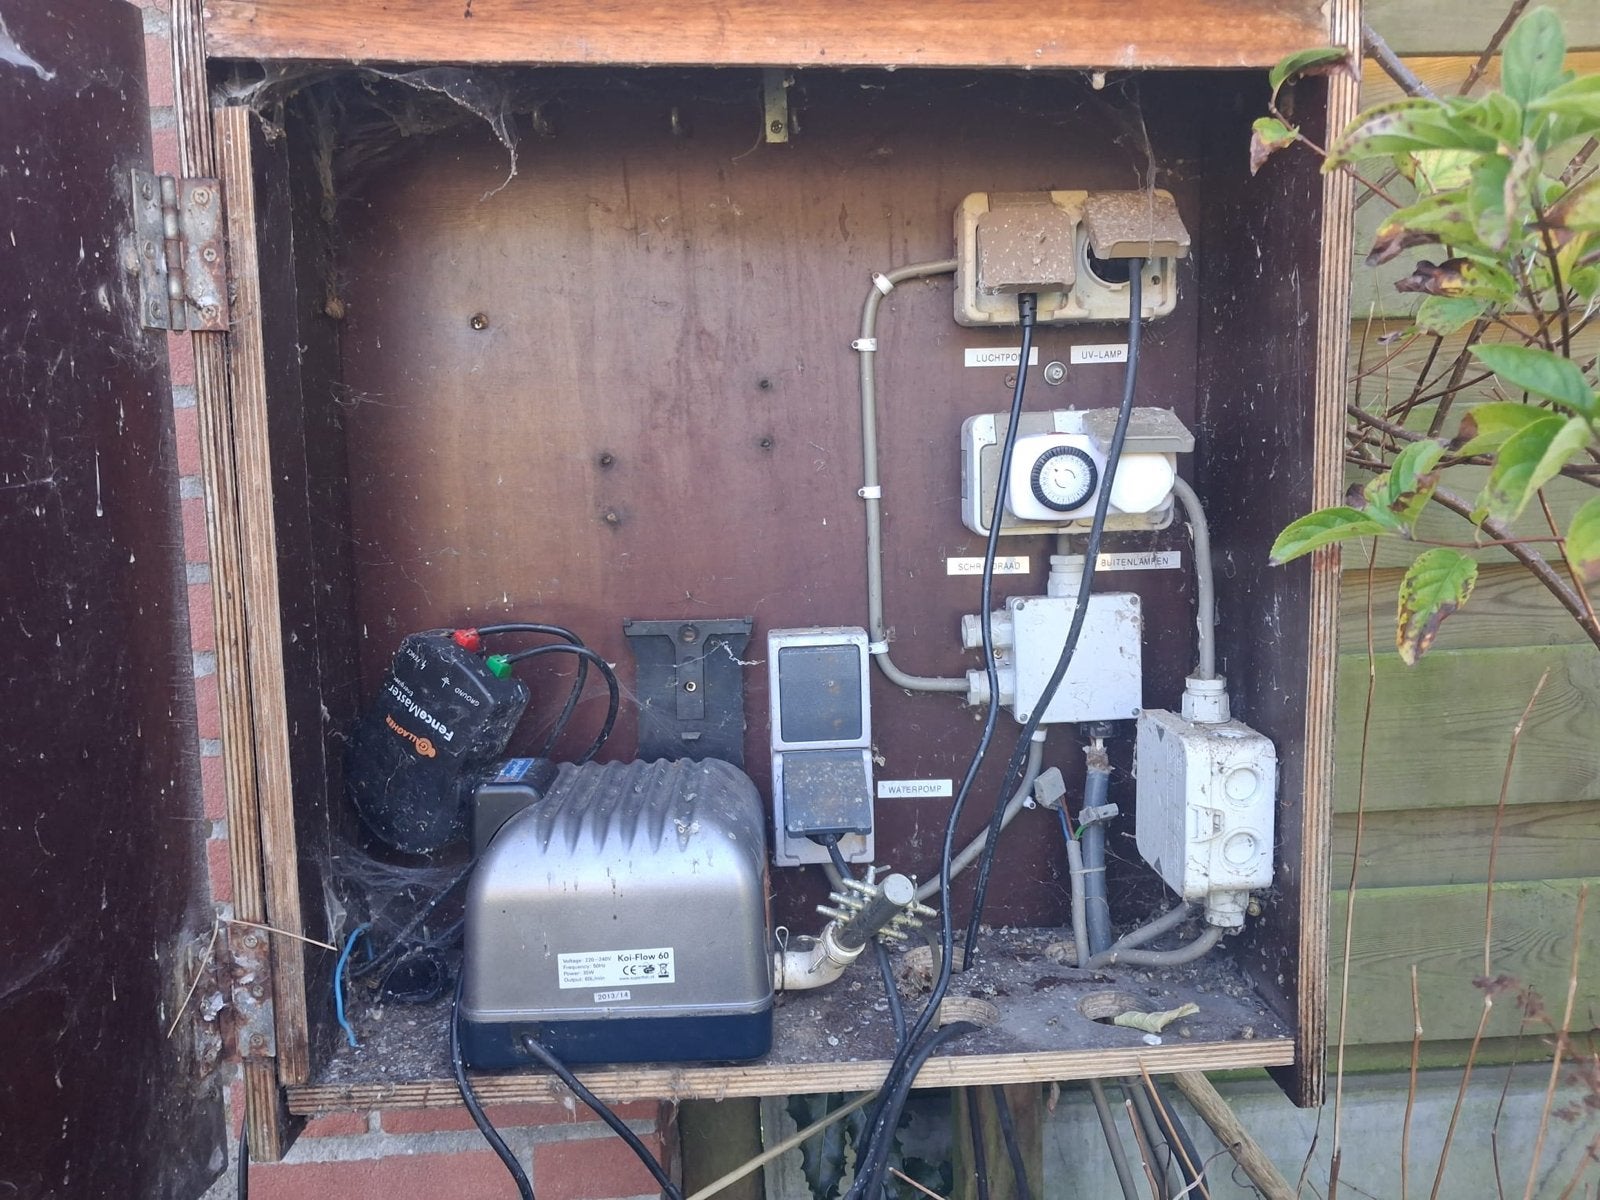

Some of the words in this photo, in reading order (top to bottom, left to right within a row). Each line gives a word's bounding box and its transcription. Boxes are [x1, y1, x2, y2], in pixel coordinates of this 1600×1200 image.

[976, 353, 1025, 363] LUCHTPO
[1081, 350, 1122, 359] UV-LAMP
[958, 561, 1021, 571] SCHRDRAAD
[1101, 557, 1169, 567] BUITENLAMPEN
[454, 686, 481, 707] GROUND
[388, 684, 454, 742] FenceMaster
[385, 714, 436, 758] GALLAGHER
[888, 785, 942, 794] WATERPOMP
[617, 953, 656, 962] Koi-Flow
[658, 952, 669, 960] 60
[598, 992, 628, 1000] 2013/14
